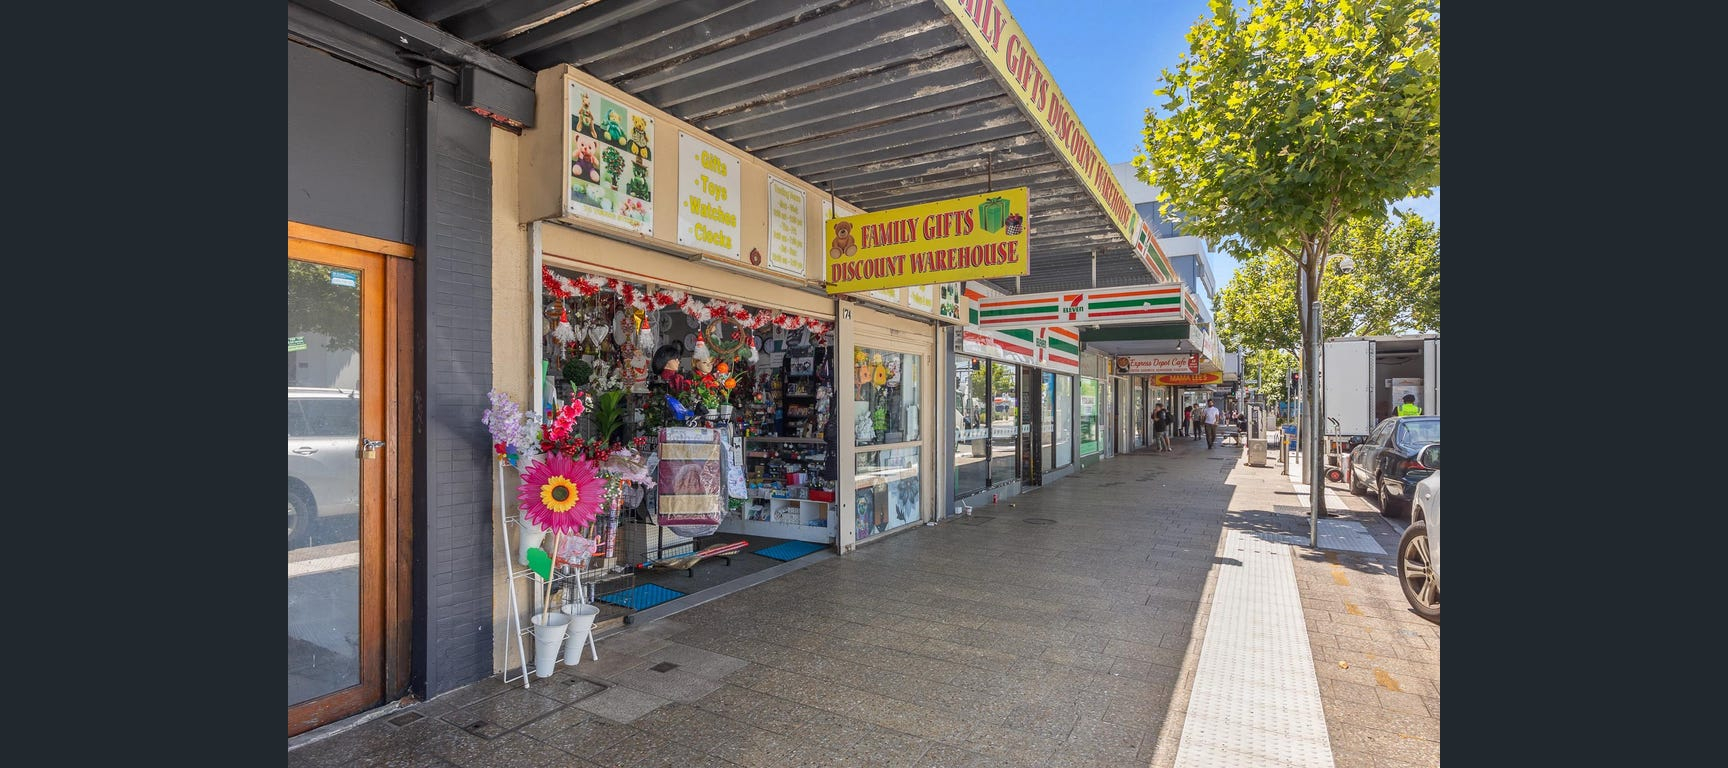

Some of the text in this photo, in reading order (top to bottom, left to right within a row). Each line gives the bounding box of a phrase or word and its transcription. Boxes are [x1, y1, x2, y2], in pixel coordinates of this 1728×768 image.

[1005, 34, 1049, 112] GIFTS
[1047, 92, 1098, 178] DISCOUNT
[1095, 161, 1132, 229] WAREHOUSE
[701, 150, 727, 176] Gifts
[701, 175, 727, 201] Toys
[689, 195, 736, 228] Watches
[694, 222, 732, 249] Clocks
[861, 208, 974, 250] FAMILY GIFTS
[831, 254, 906, 283] DISCOUNT
[909, 240, 1019, 275] WAREHOUSE
[1130, 359, 1152, 368] Express
[1153, 358, 1170, 368] Depot
